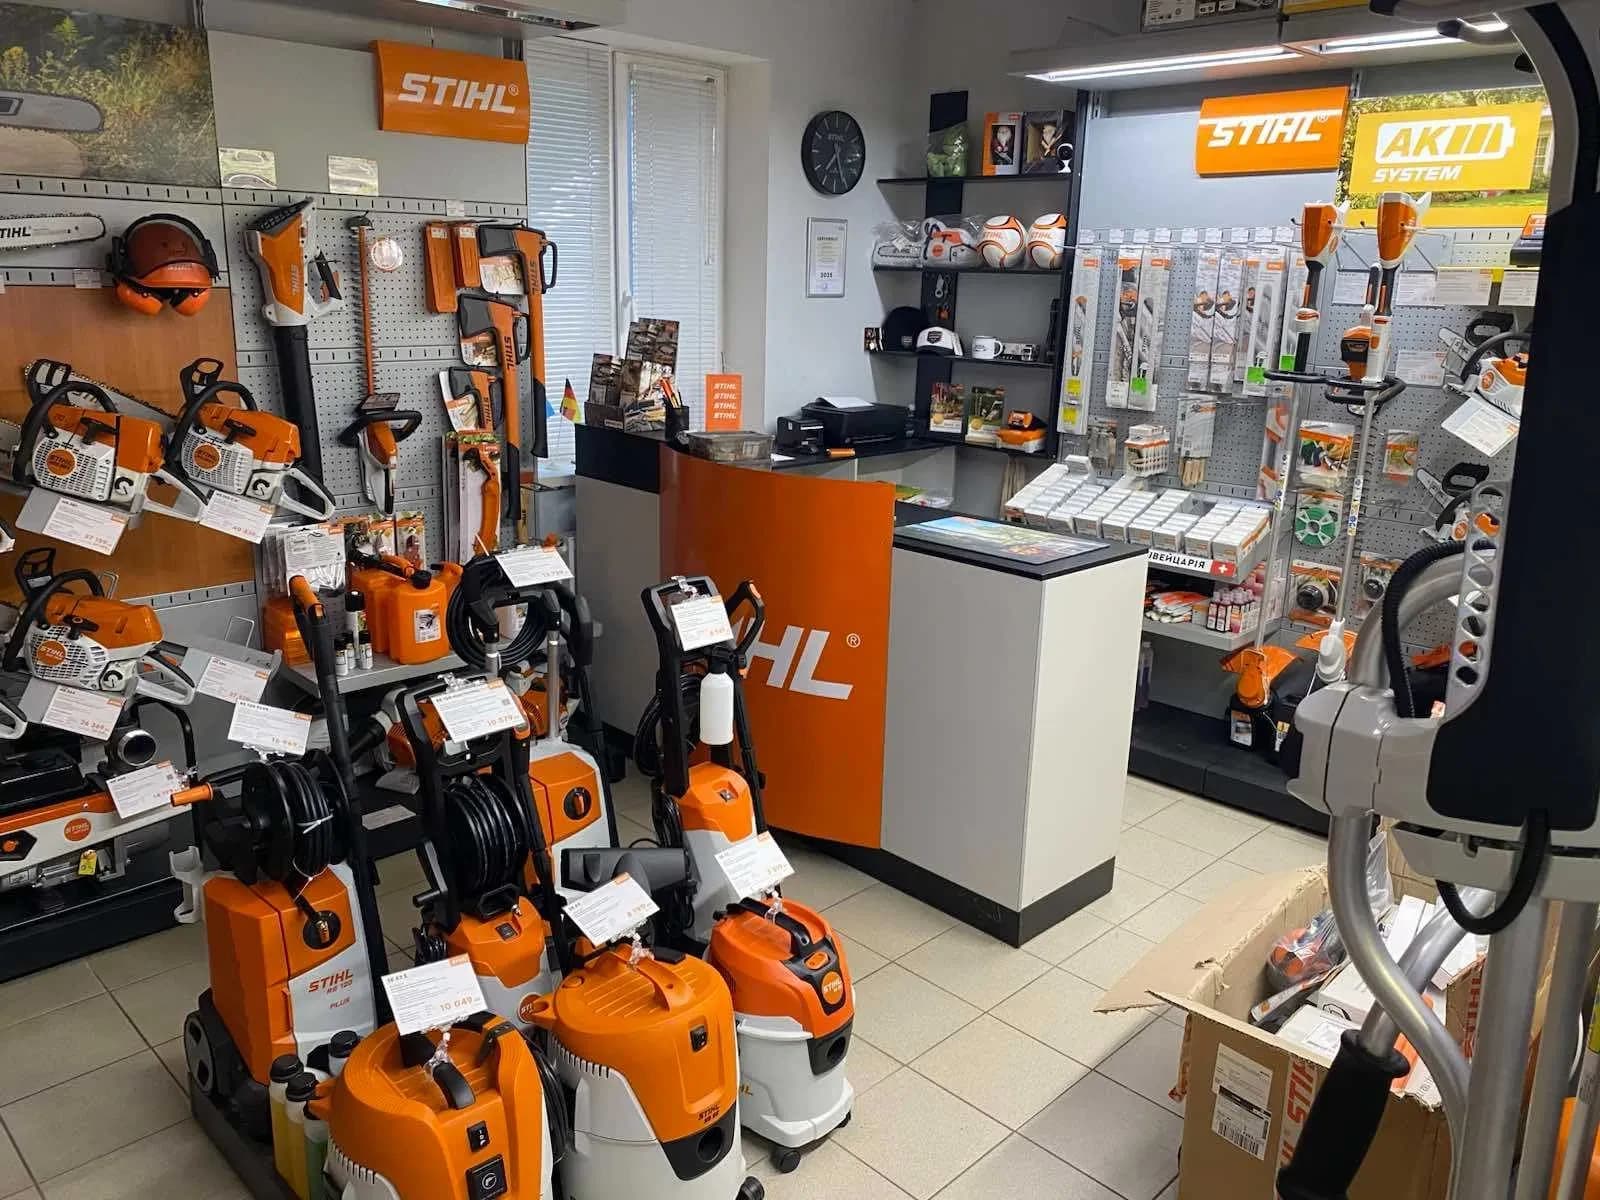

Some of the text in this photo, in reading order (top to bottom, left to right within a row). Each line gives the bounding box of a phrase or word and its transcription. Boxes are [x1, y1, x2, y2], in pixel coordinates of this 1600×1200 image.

[398, 72, 516, 114] STIHL
[1208, 113, 1322, 148] STIHL
[1373, 165, 1463, 183] SYSTEM
[0, 227, 31, 238] TIHL
[504, 336, 514, 370] STIHL
[733, 615, 854, 700] HL
[309, 969, 354, 993] STIHL
[341, 981, 353, 989] 120
[329, 996, 351, 1010] PLUS
[440, 1002, 451, 1012] 10
[698, 1104, 720, 1121] STIHL
